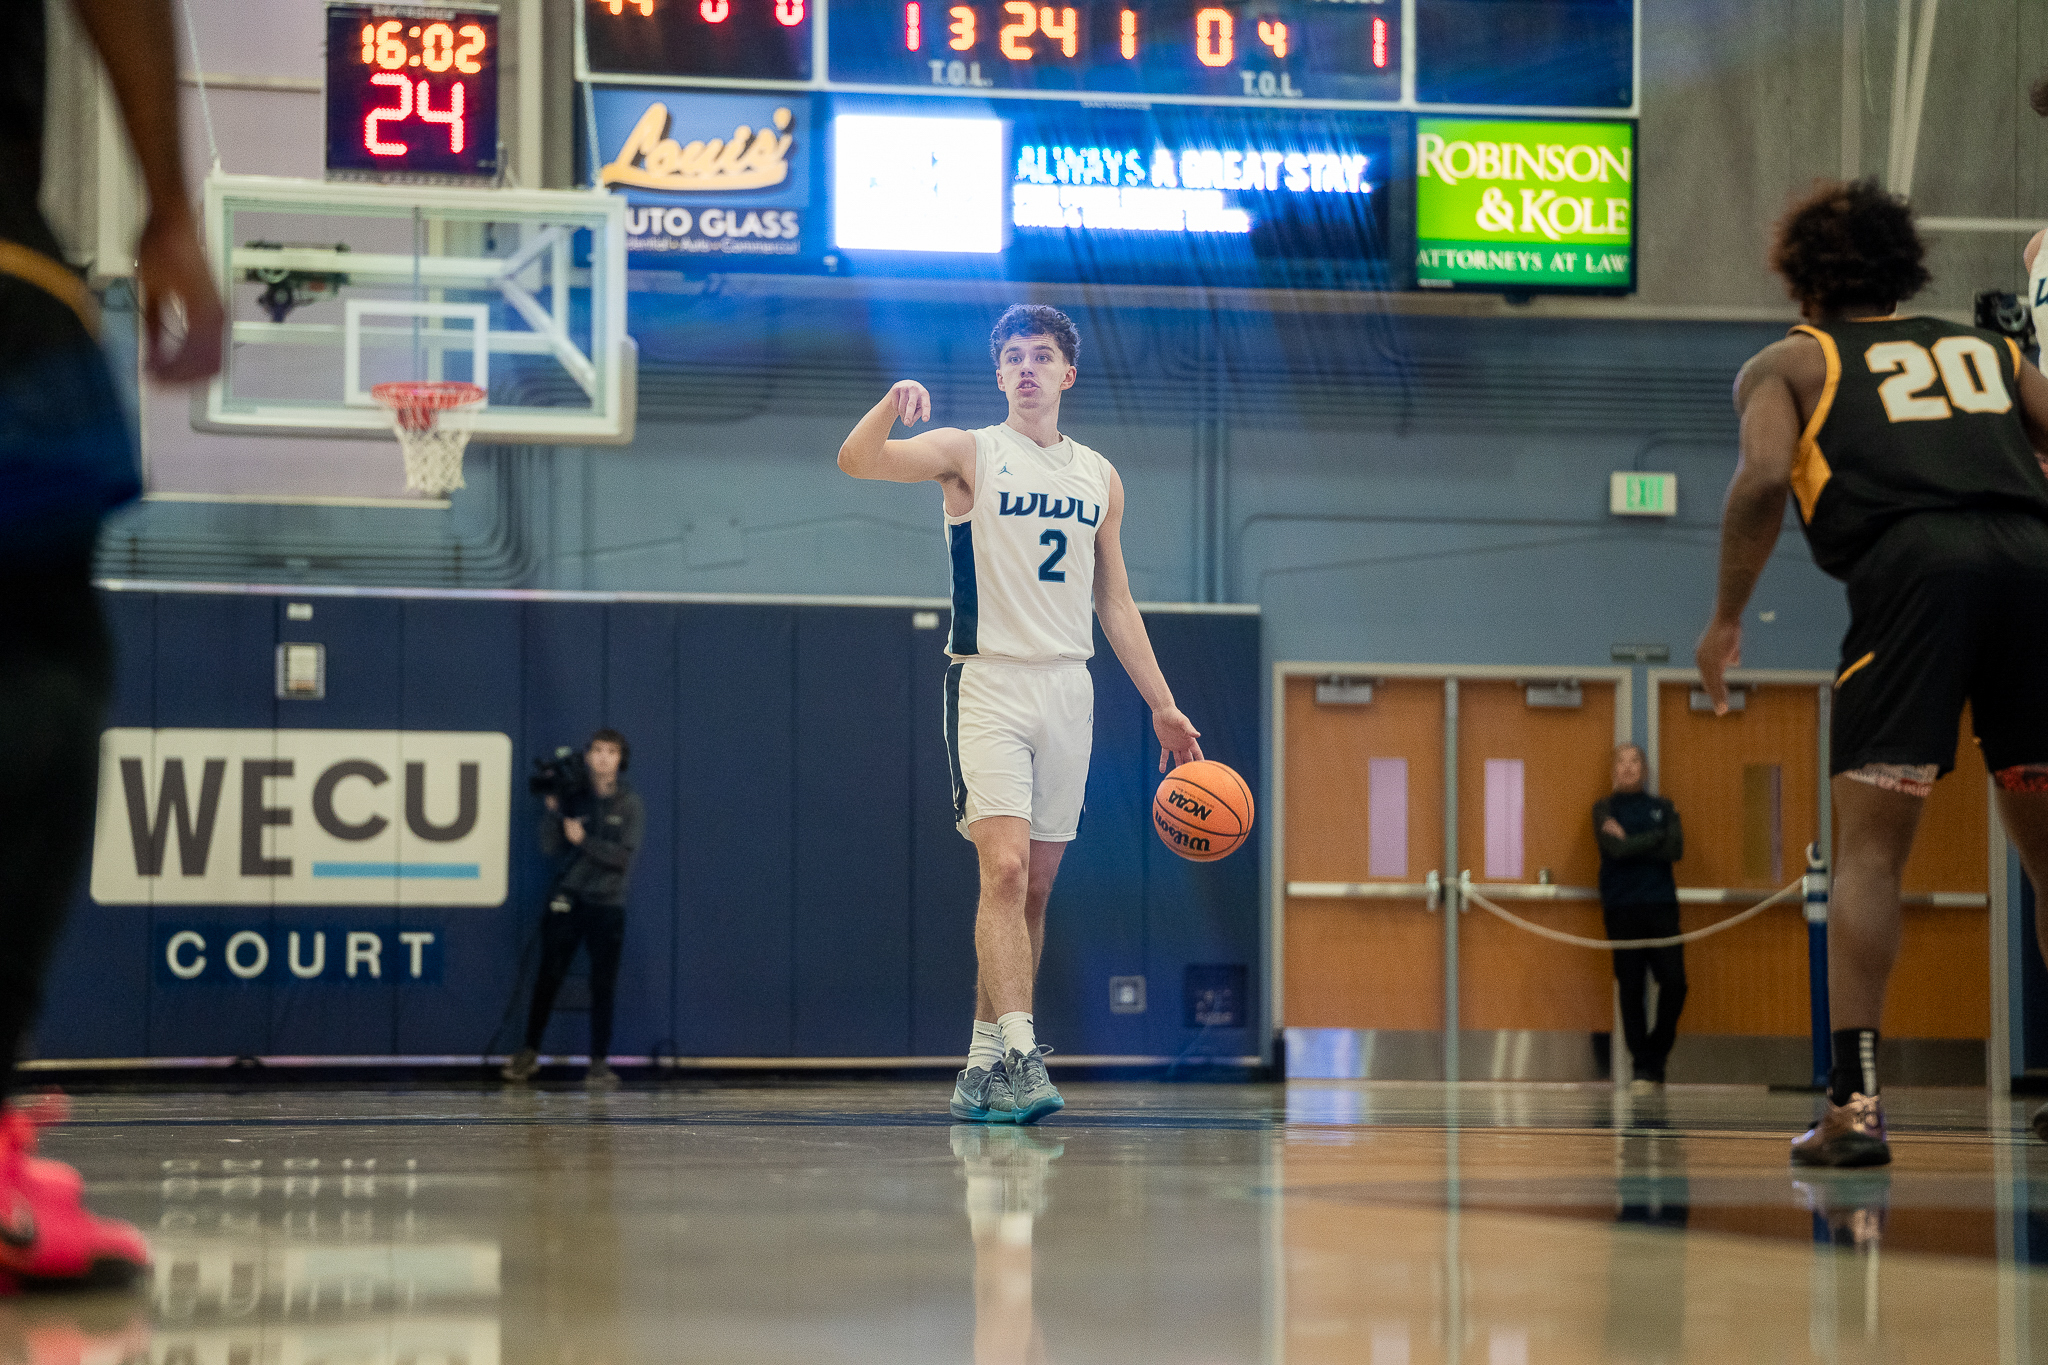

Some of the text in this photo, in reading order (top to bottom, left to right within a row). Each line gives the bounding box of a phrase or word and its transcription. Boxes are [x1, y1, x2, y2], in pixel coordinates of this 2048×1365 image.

[361, 20, 486, 73] 16:02
[950, 6, 976, 51] 3
[1000, 1, 1077, 60] 24
[1196, 8, 1233, 67] 0
[1258, 21, 1287, 58] 4
[364, 73, 464, 156] 24
[1416, 133, 1631, 186] ROBINSON
[625, 207, 800, 239] UTO GLASS
[1475, 187, 1630, 241] & KOLE
[1417, 248, 1631, 274] ATTORNEYS AT LAW
[1863, 335, 2013, 424] 20
[997, 491, 1100, 528] WWU
[1038, 529, 1068, 583] 2
[119, 757, 481, 877] WECU
[1155, 810, 1210, 852] Wilson
[1168, 790, 1212, 821] NCAA
[165, 930, 435, 979] COURT
